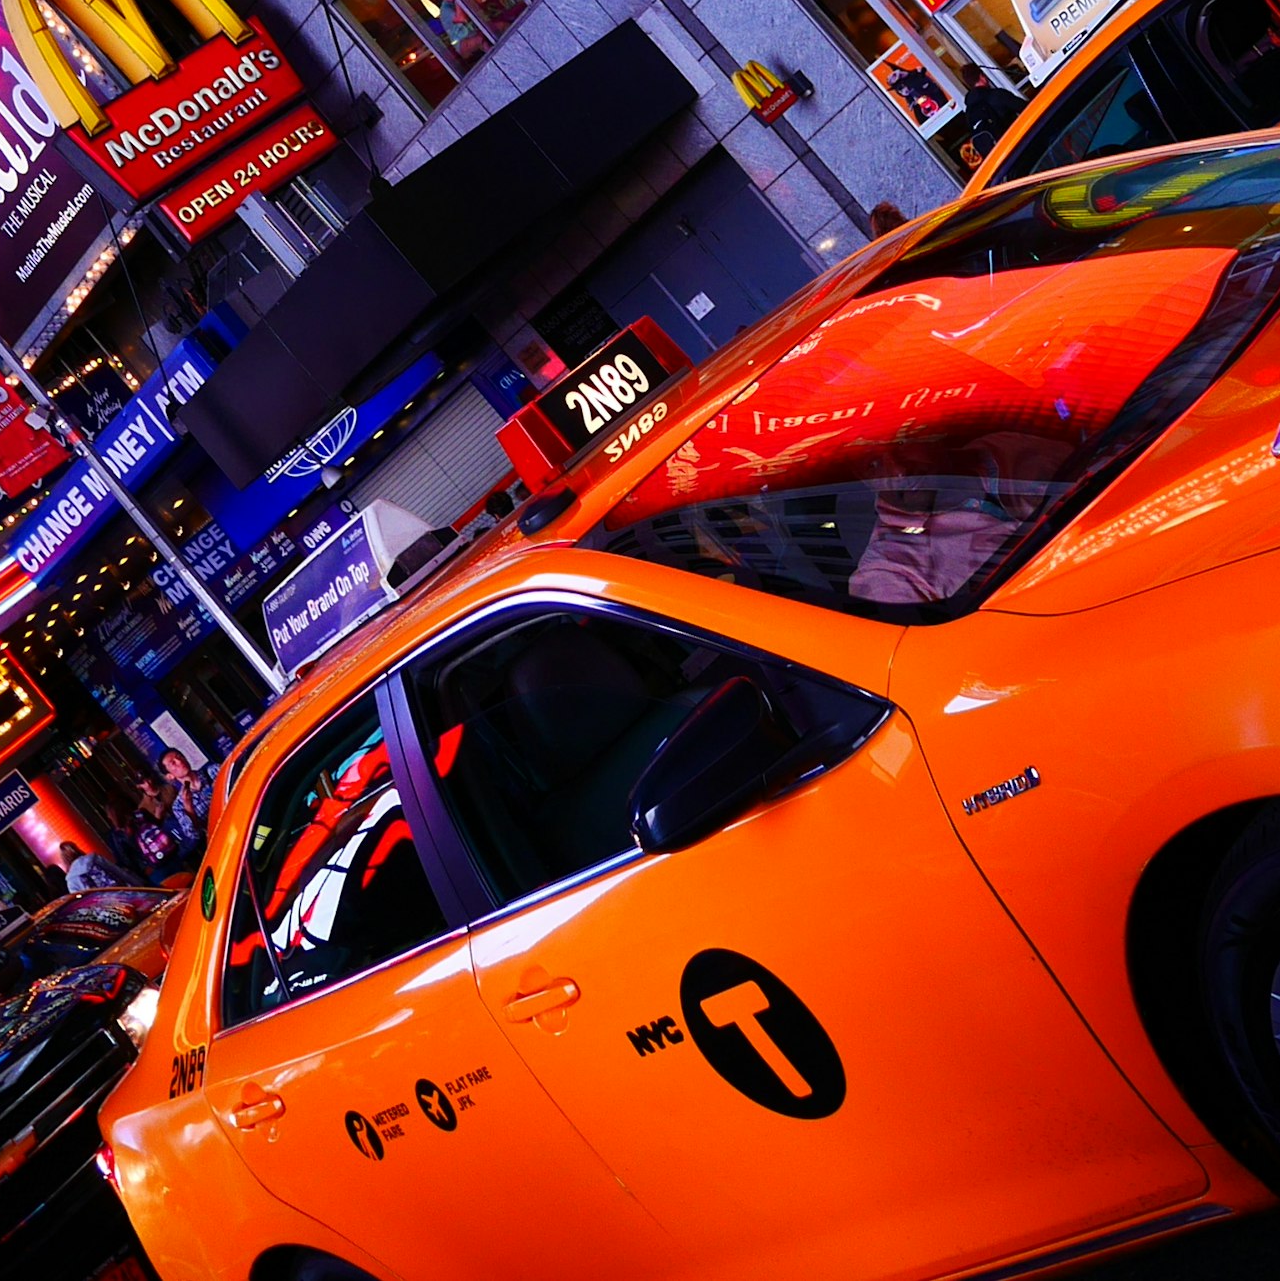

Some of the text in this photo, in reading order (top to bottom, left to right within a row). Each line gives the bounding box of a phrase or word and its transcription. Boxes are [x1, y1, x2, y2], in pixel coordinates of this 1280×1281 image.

[104, 49, 279, 168] McDonald's
[152, 88, 268, 168] Restaurant
[4, 168, 57, 238] THE MUSICAL
[178, 126, 324, 223] OPEN 24 HOURS
[15, 183, 94, 283] MatildaTheMusical.com
[565, 353, 649, 434] 2N89
[13, 486, 94, 573] CHANGE
[309, 520, 332, 543] NYC
[272, 622, 293, 649] Put
[286, 609, 310, 636] Your
[306, 582, 341, 620] Brand
[335, 575, 353, 597] On
[347, 561, 370, 586] Top
[961, 773, 1030, 816] HYBRID
[625, 1015, 685, 1057] NYC
[169, 1045, 205, 1099] 2N89
[444, 1065, 492, 1096] FLAT FARE
[456, 1093, 476, 1112] JFK
[371, 1102, 410, 1128] METERED
[381, 1123, 405, 1142] FARE
